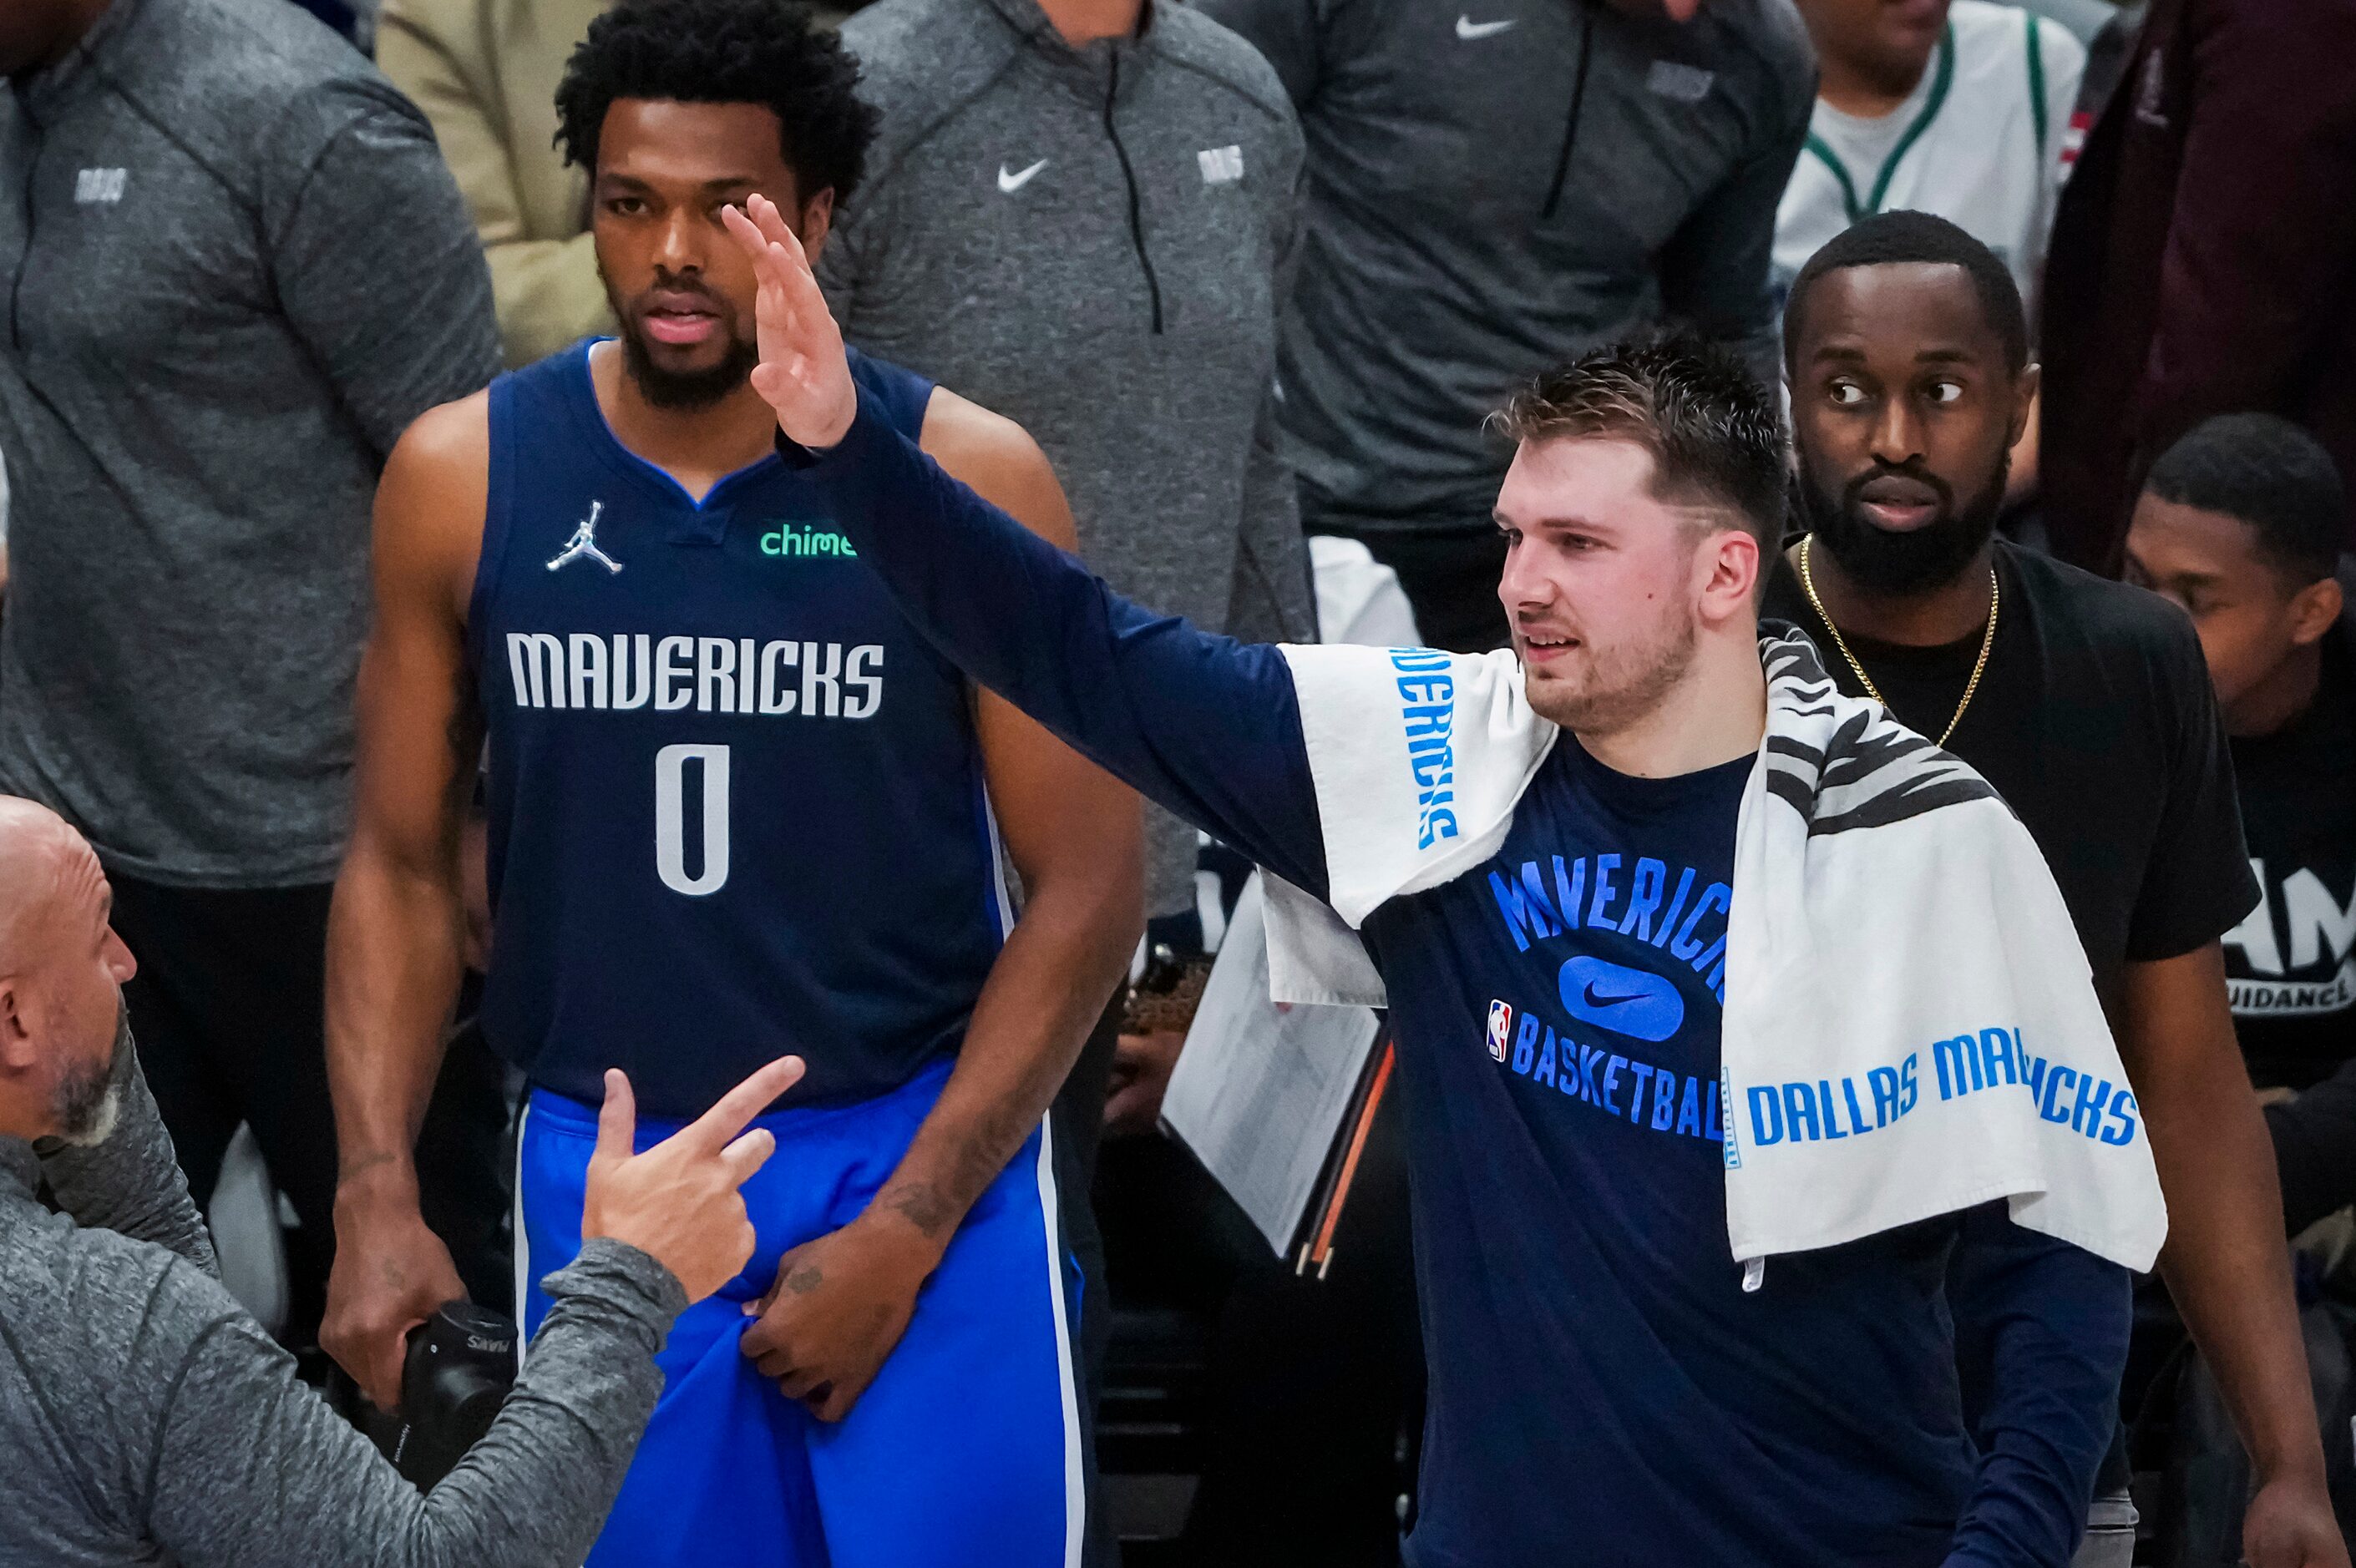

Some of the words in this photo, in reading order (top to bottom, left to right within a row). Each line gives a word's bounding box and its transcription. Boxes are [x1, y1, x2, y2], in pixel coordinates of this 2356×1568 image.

[506, 632, 884, 719] MAVERICKS
[656, 743, 730, 897] 0
[1746, 1051, 1918, 1146] DALLAS
